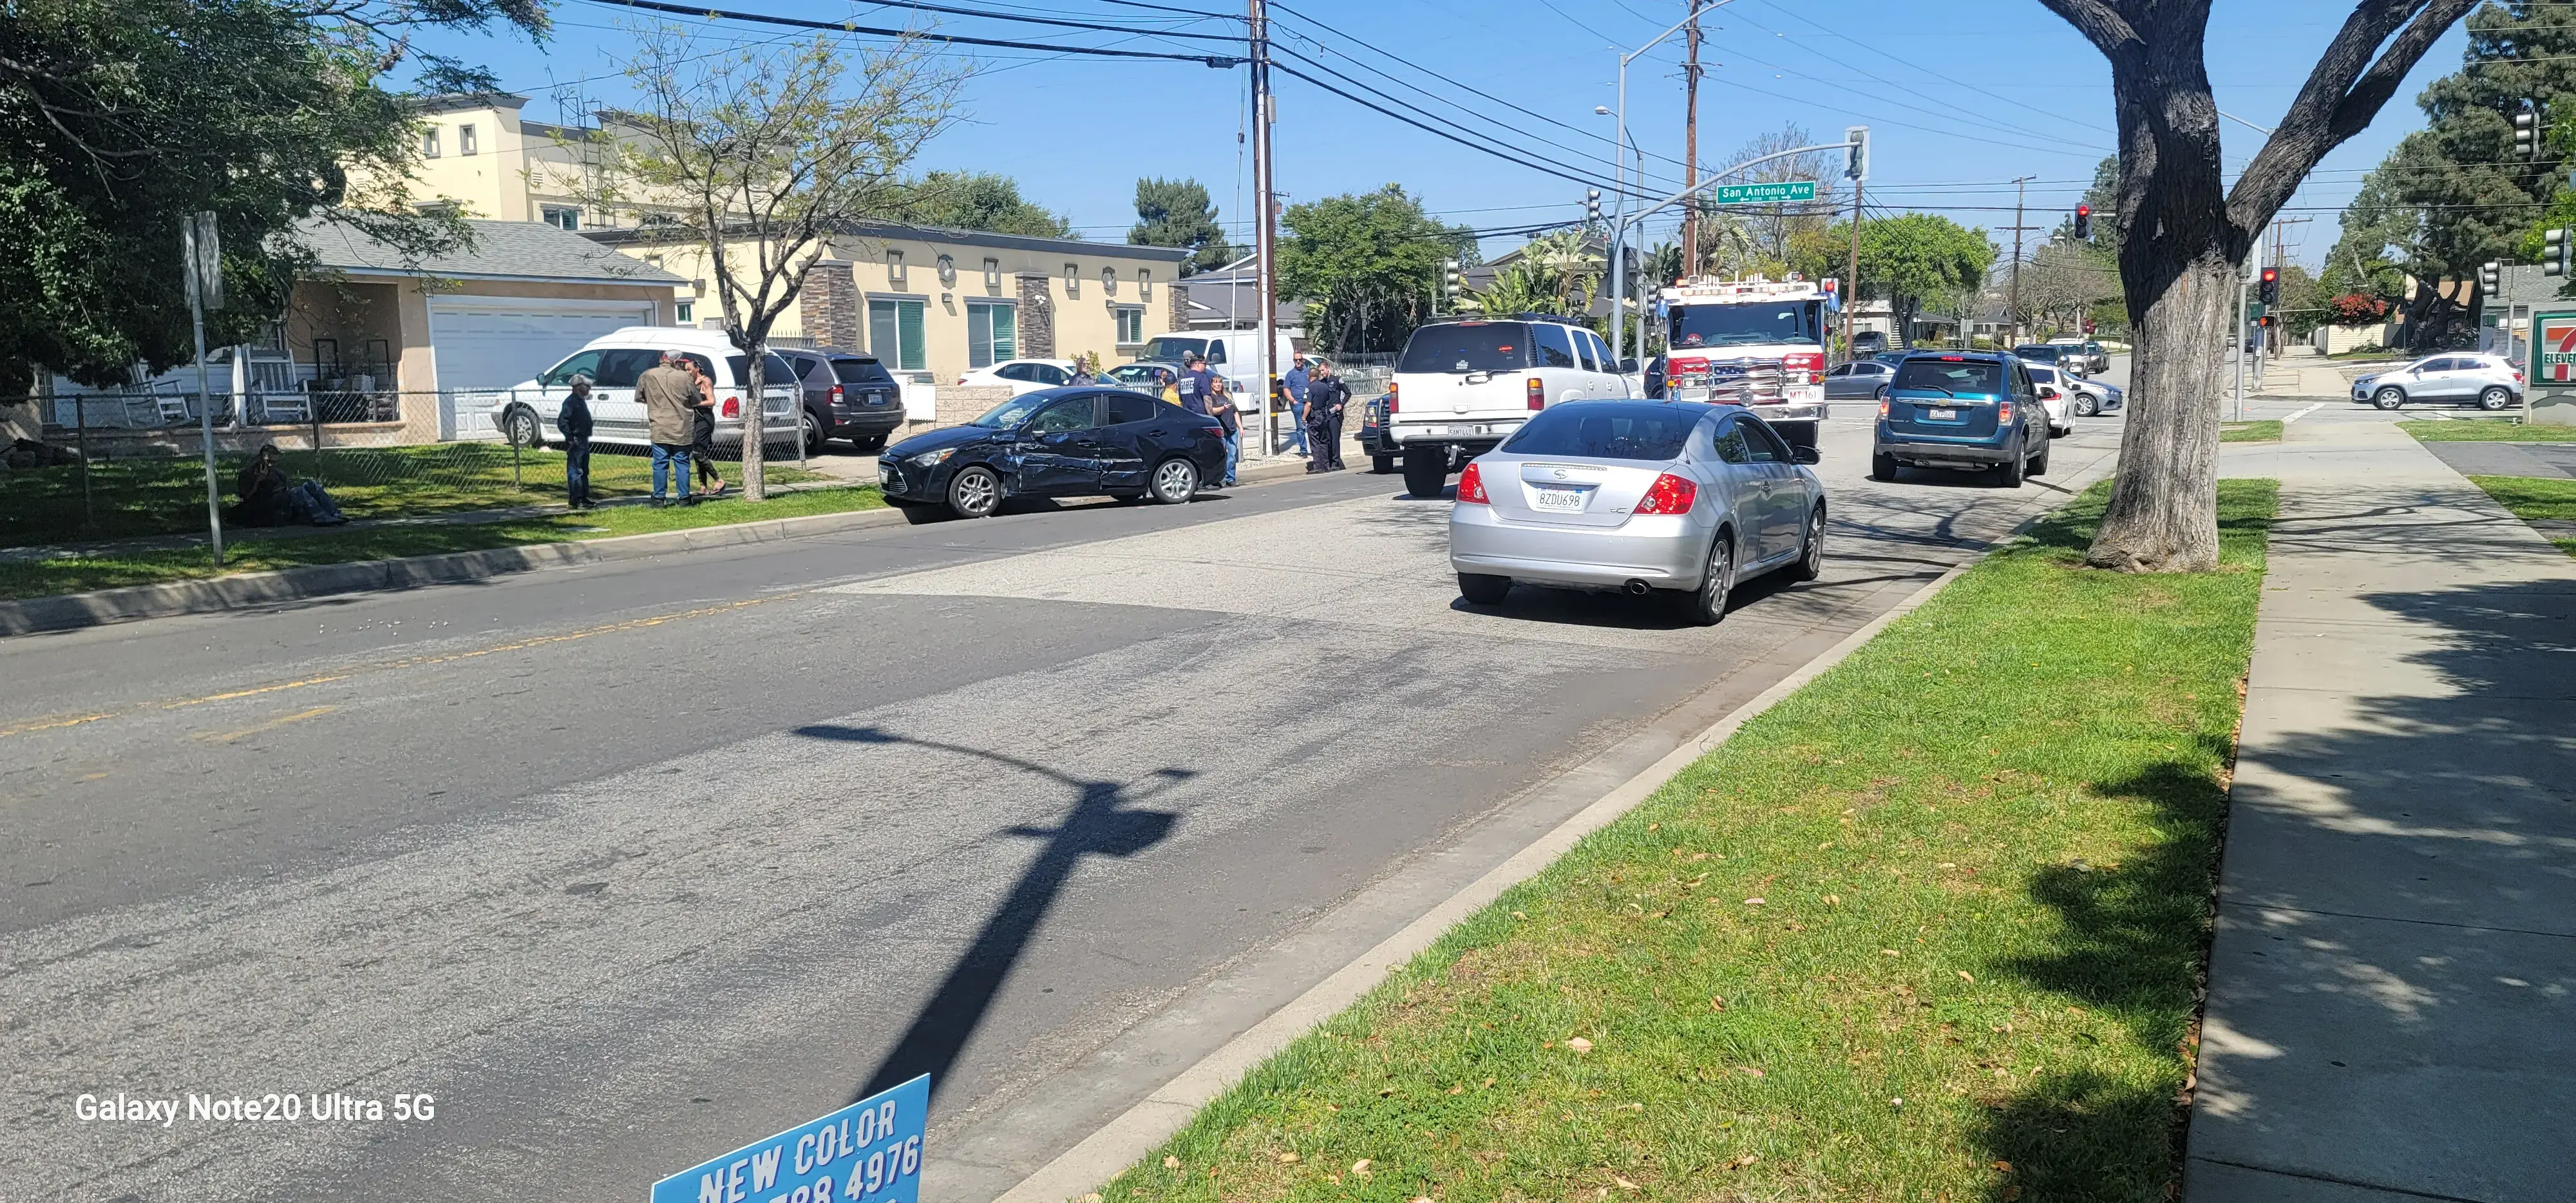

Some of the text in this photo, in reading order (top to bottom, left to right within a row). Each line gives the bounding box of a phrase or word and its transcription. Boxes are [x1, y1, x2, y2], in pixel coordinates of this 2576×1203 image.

[1722, 184, 1810, 198] San Antonio Ave
[1180, 381, 1194, 391] FIRE
[1790, 390, 1816, 399] MT 161
[1540, 493, 1580, 507] 8ZDU698
[697, 1145, 783, 1203] NEW
[793, 1099, 896, 1175] COLOR
[844, 1134, 922, 1202] 4976
